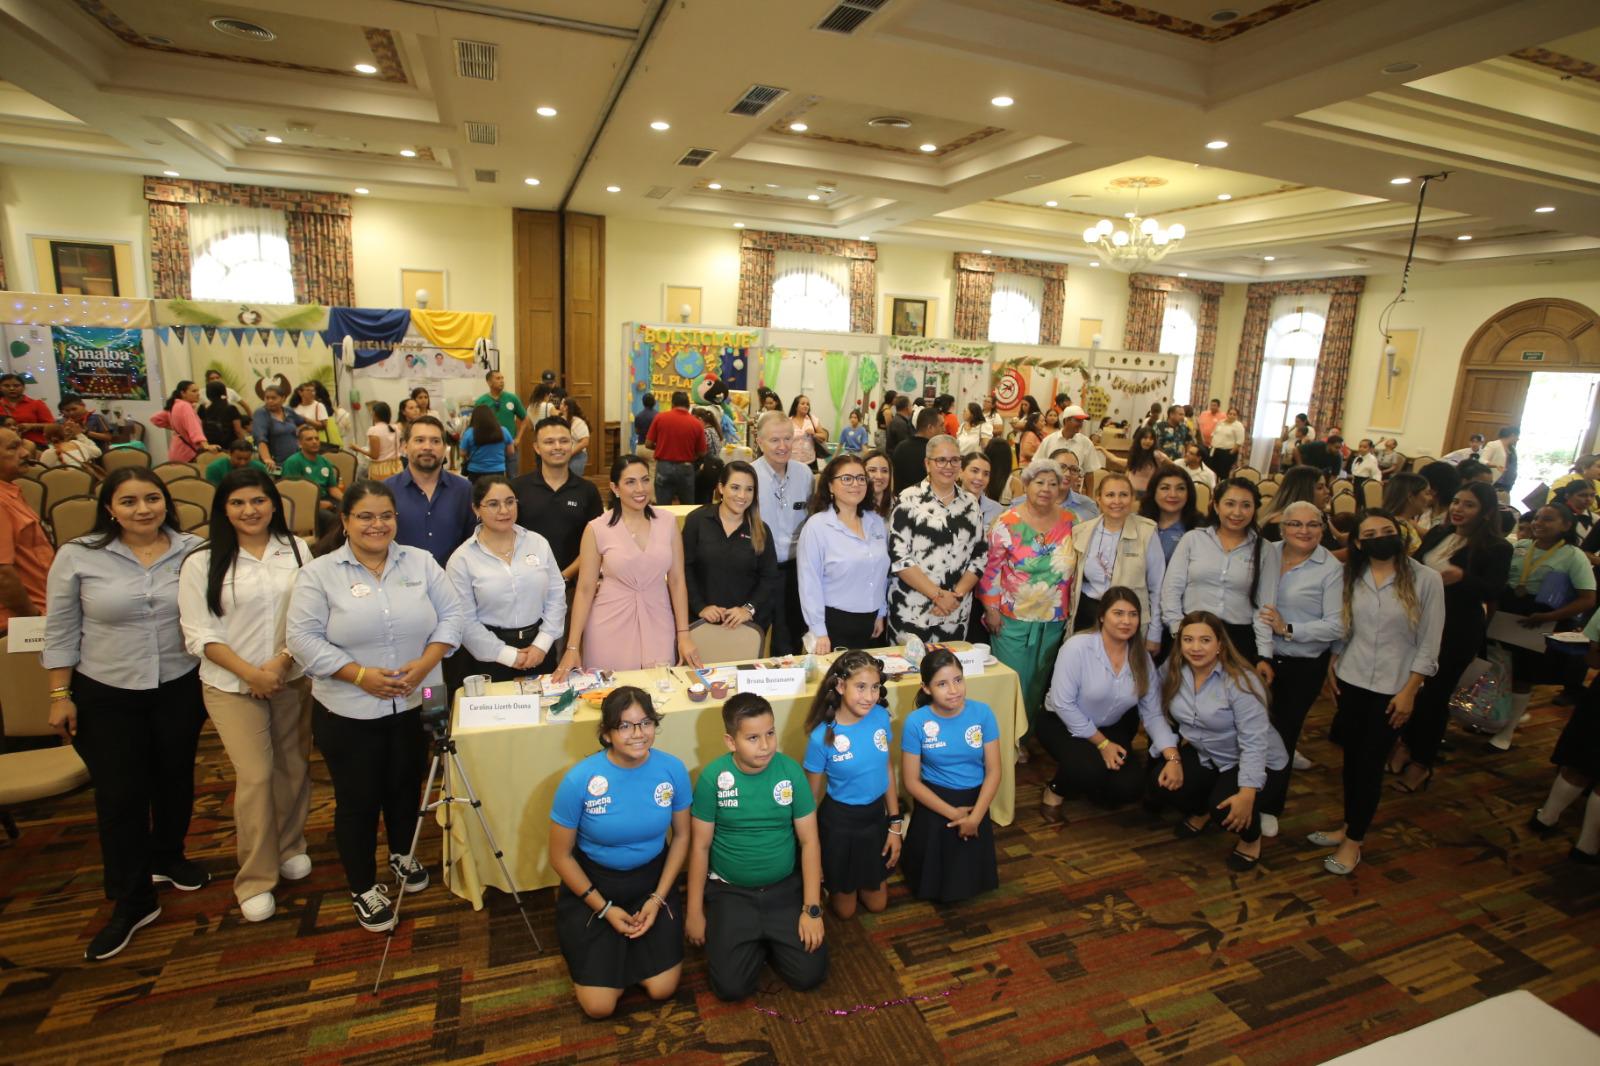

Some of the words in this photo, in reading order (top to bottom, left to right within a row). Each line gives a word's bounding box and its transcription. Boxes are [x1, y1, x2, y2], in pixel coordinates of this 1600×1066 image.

[643, 327, 751, 350] BOLSICLAJE
[67, 344, 130, 361] Sinaloa
[78, 359, 125, 369] produce
[832, 751, 854, 762] Sarah
[717, 787, 739, 798] aniel
[717, 799, 739, 808] suna
